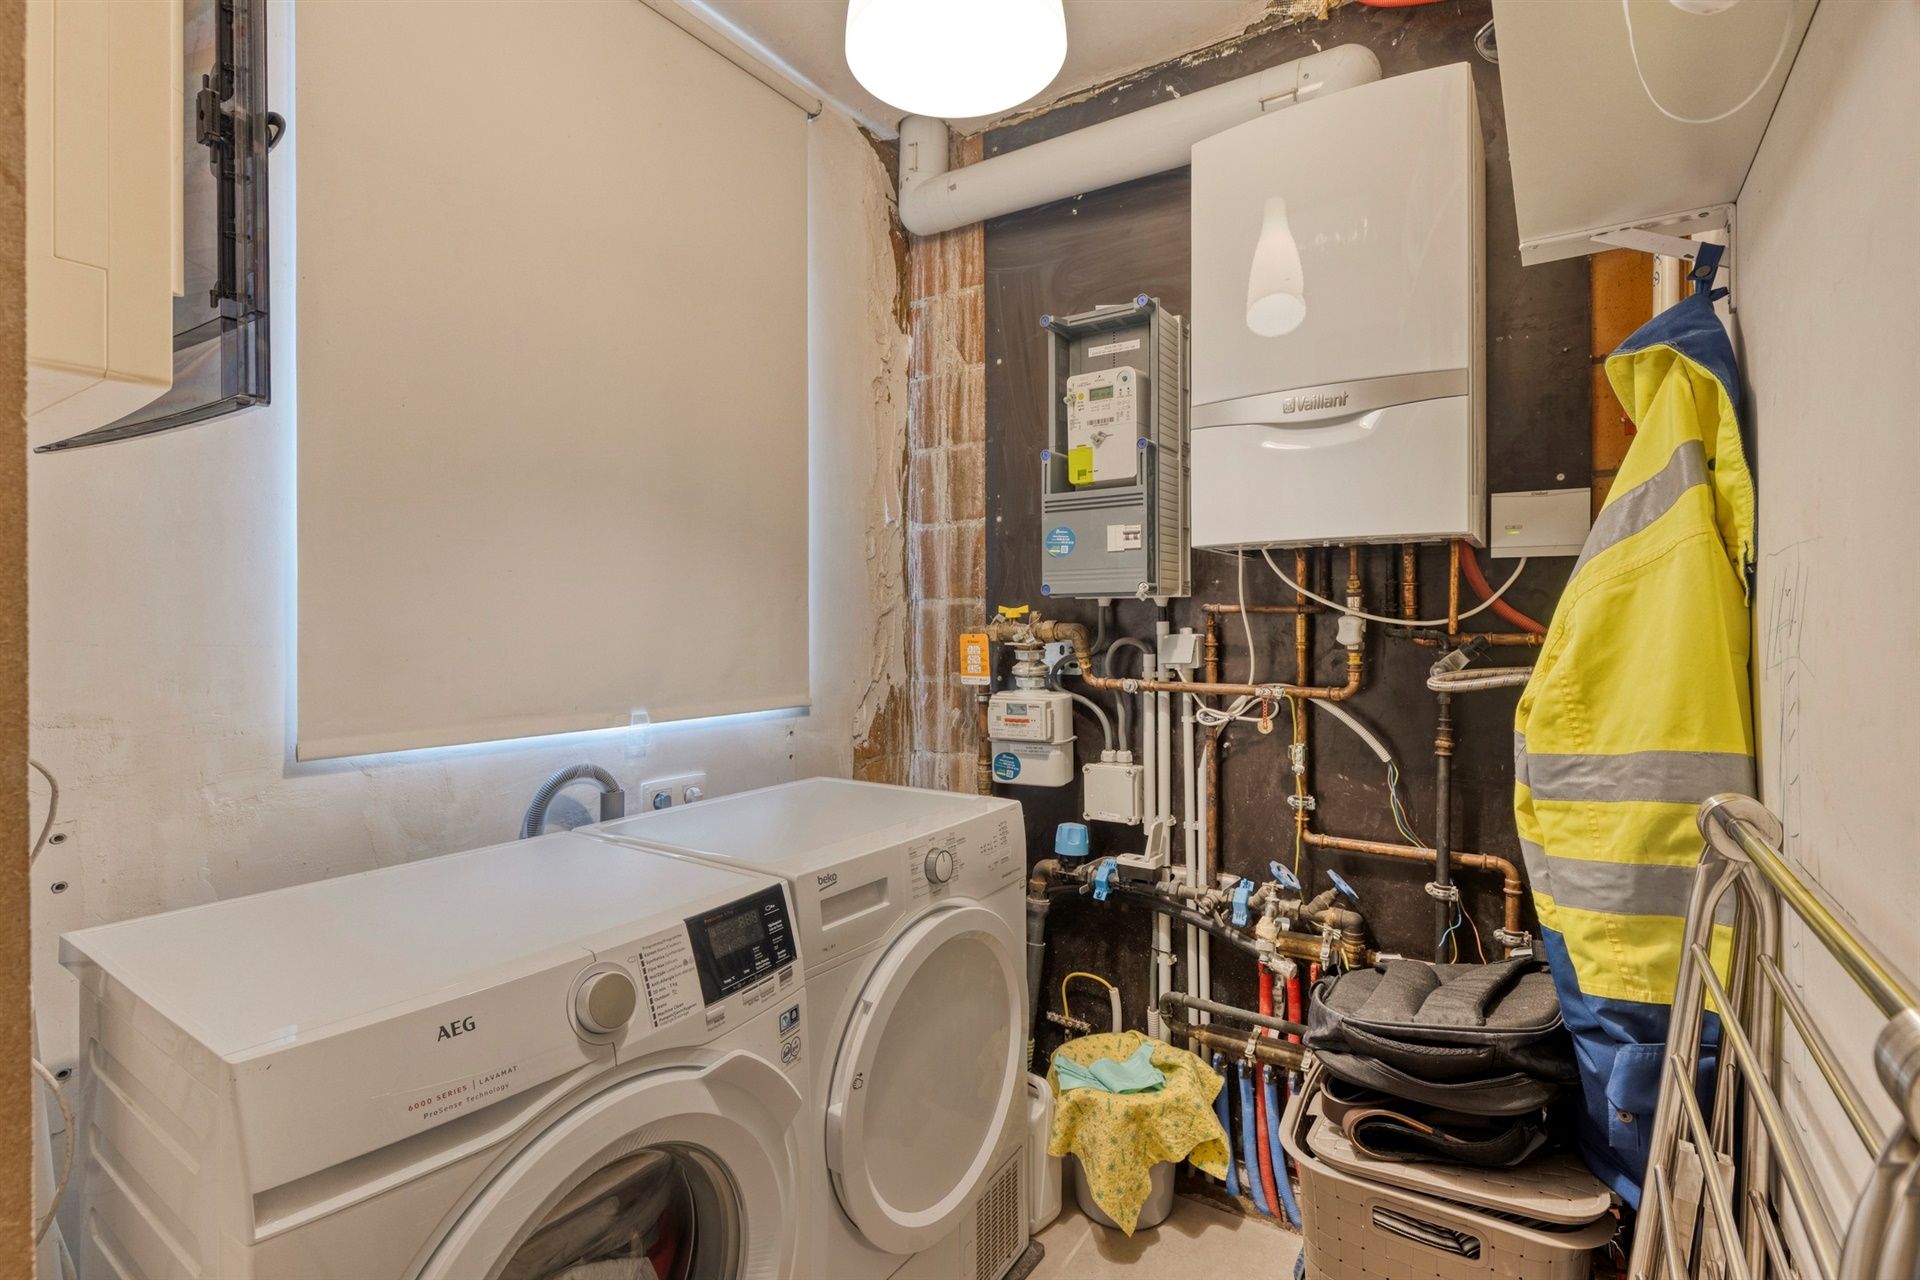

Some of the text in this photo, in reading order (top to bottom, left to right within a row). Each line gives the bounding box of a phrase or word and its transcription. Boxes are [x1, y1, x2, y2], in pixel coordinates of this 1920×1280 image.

[1297, 391, 1348, 412] Vaillant
[817, 873, 838, 886] beko
[437, 1015, 477, 1042] AEG
[408, 1065, 518, 1112] 6000 SERIES LAVAMAT
[423, 1083, 509, 1120] ProSense Technology
